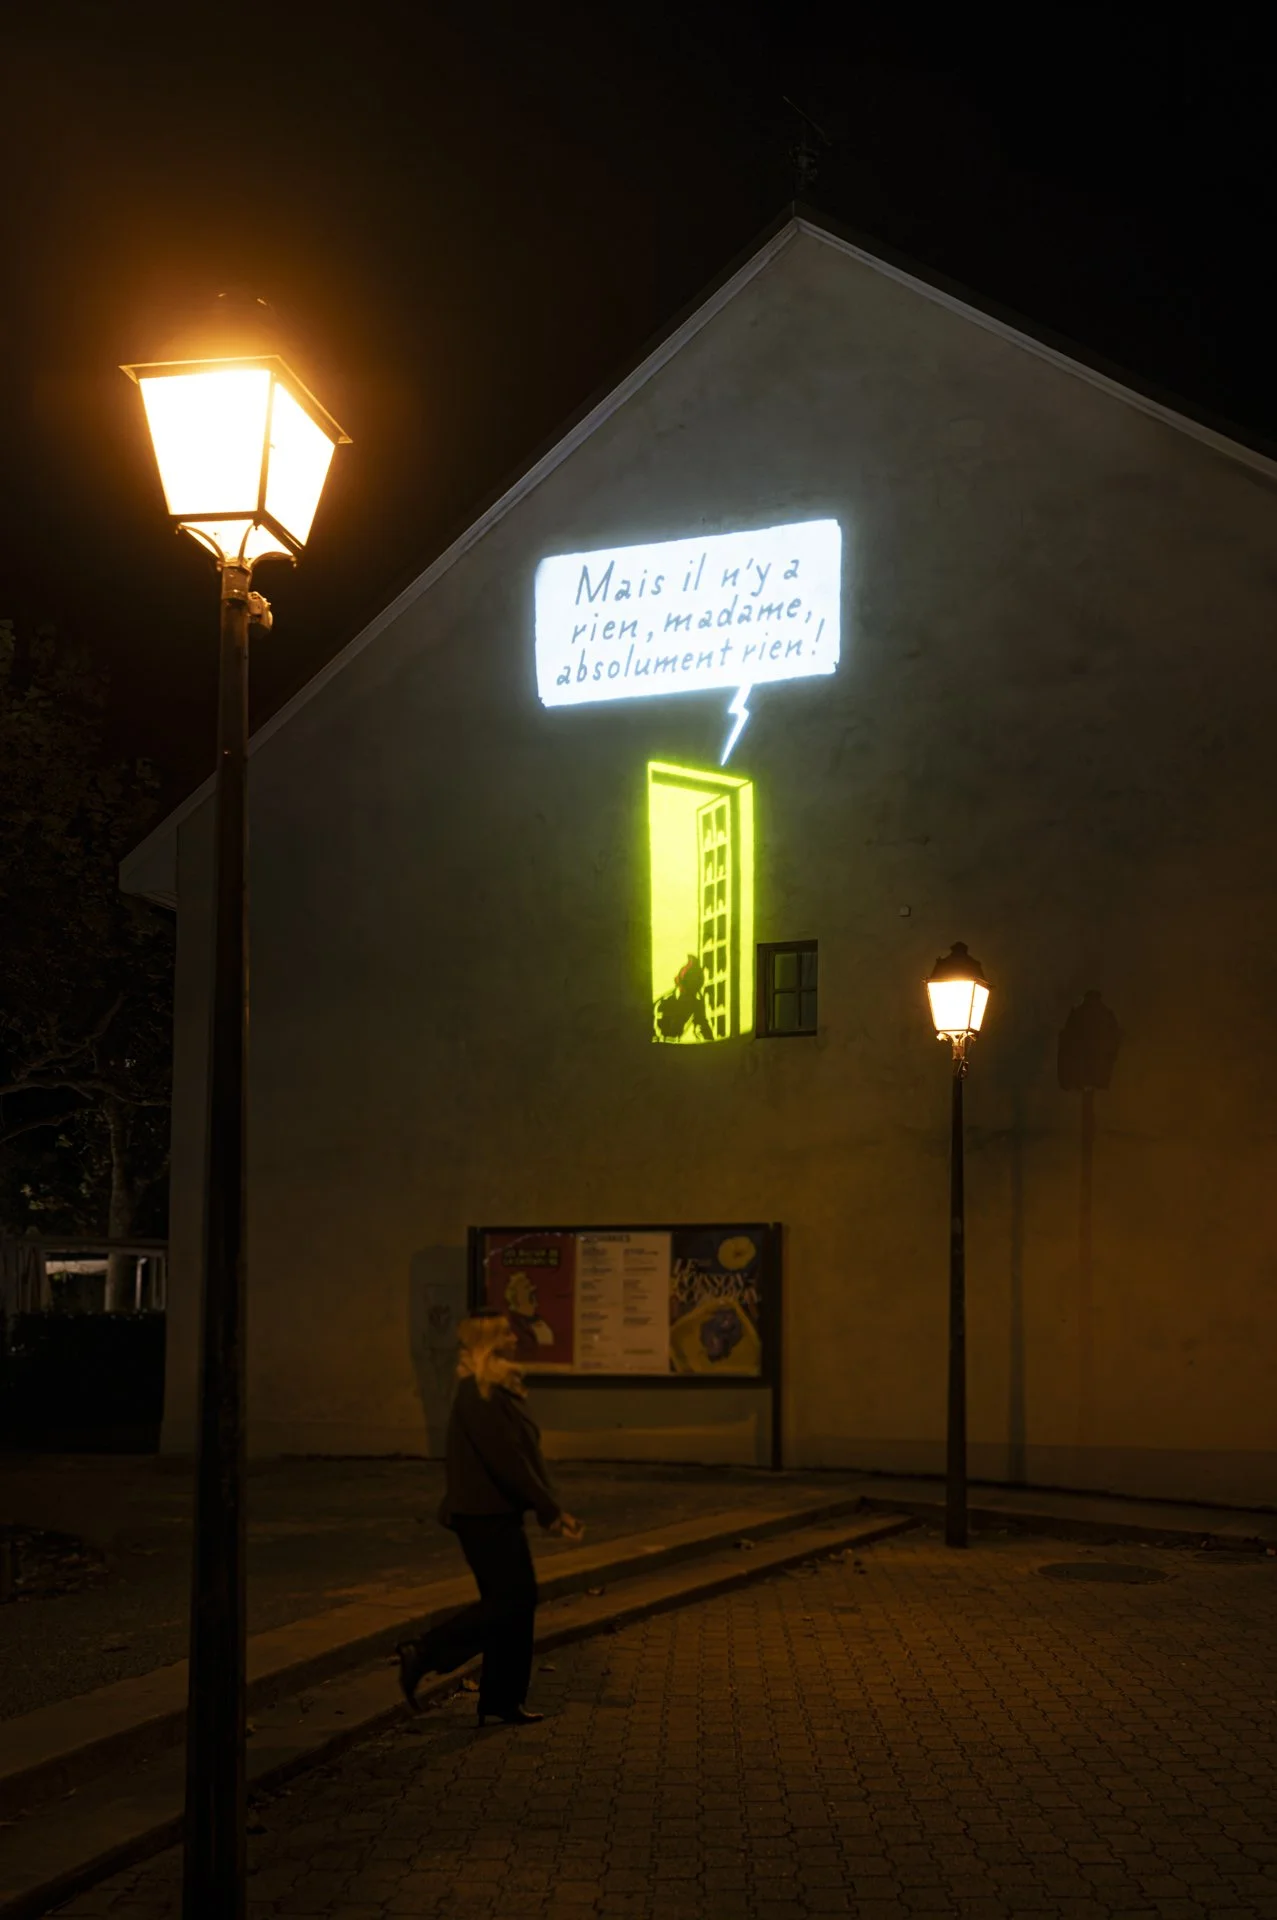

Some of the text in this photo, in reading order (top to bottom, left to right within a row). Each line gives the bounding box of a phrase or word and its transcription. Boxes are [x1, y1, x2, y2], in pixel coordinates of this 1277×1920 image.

[575, 552, 800, 606] Mais il n'y a
[571, 595, 813, 644] rien, madame,
[556, 618, 825, 686] absolument rien!
